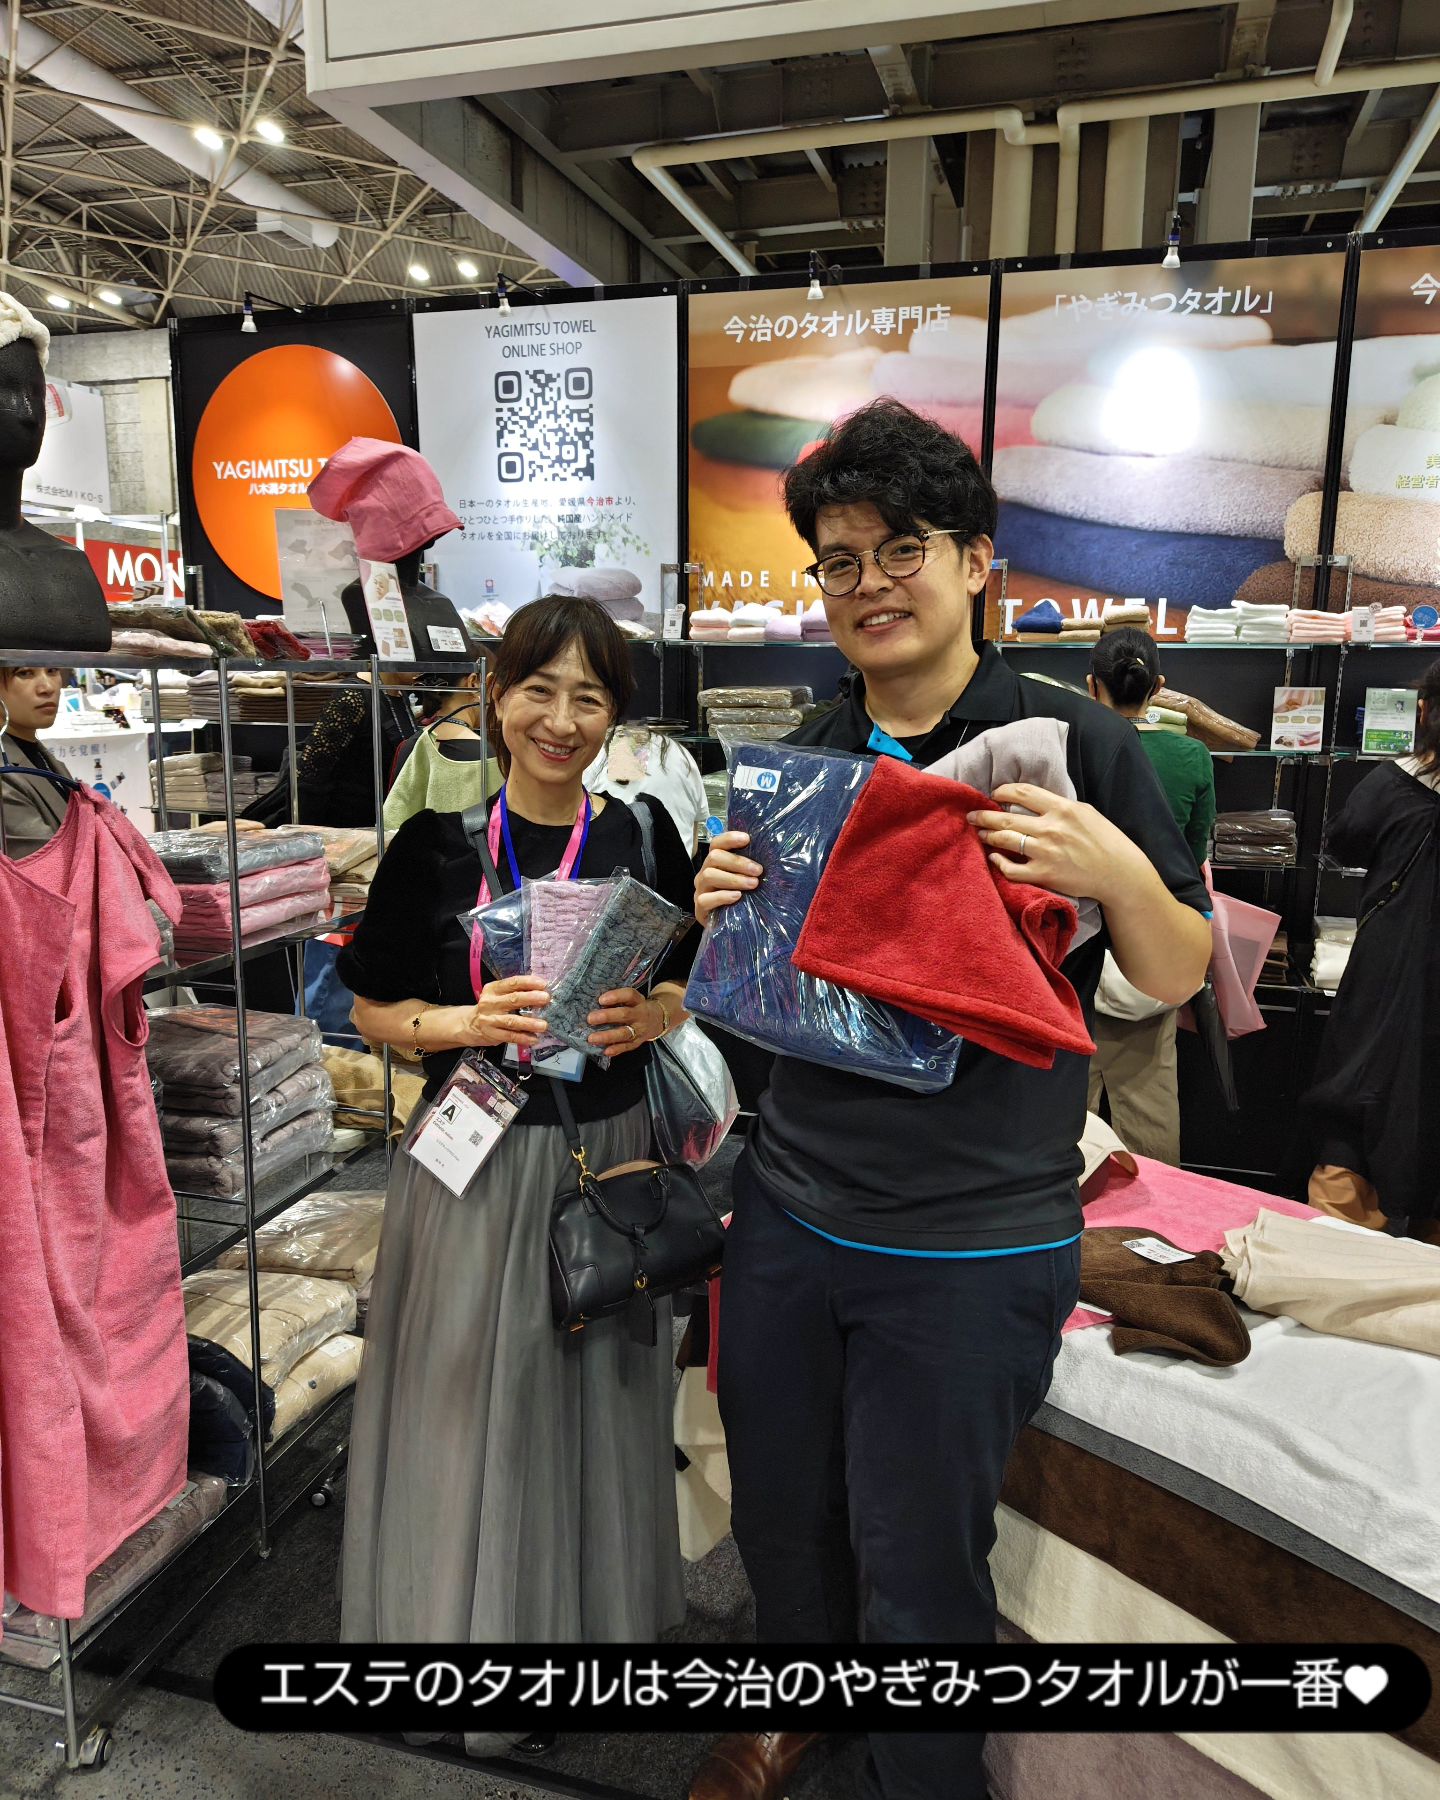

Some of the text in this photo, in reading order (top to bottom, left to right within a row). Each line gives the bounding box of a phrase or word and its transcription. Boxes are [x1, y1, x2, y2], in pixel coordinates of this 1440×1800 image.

[1055, 285, 1273, 322] 「やぎみつタオル」
[484, 320, 597, 339] YAGIMITSU TOWEL
[723, 303, 951, 343] 今治のタオル専門店
[502, 341, 582, 358] ONLINE SHOP
[212, 459, 313, 480] YAGIMITSU
[702, 570, 770, 588] MADE
[442, 1104, 456, 1122] A
